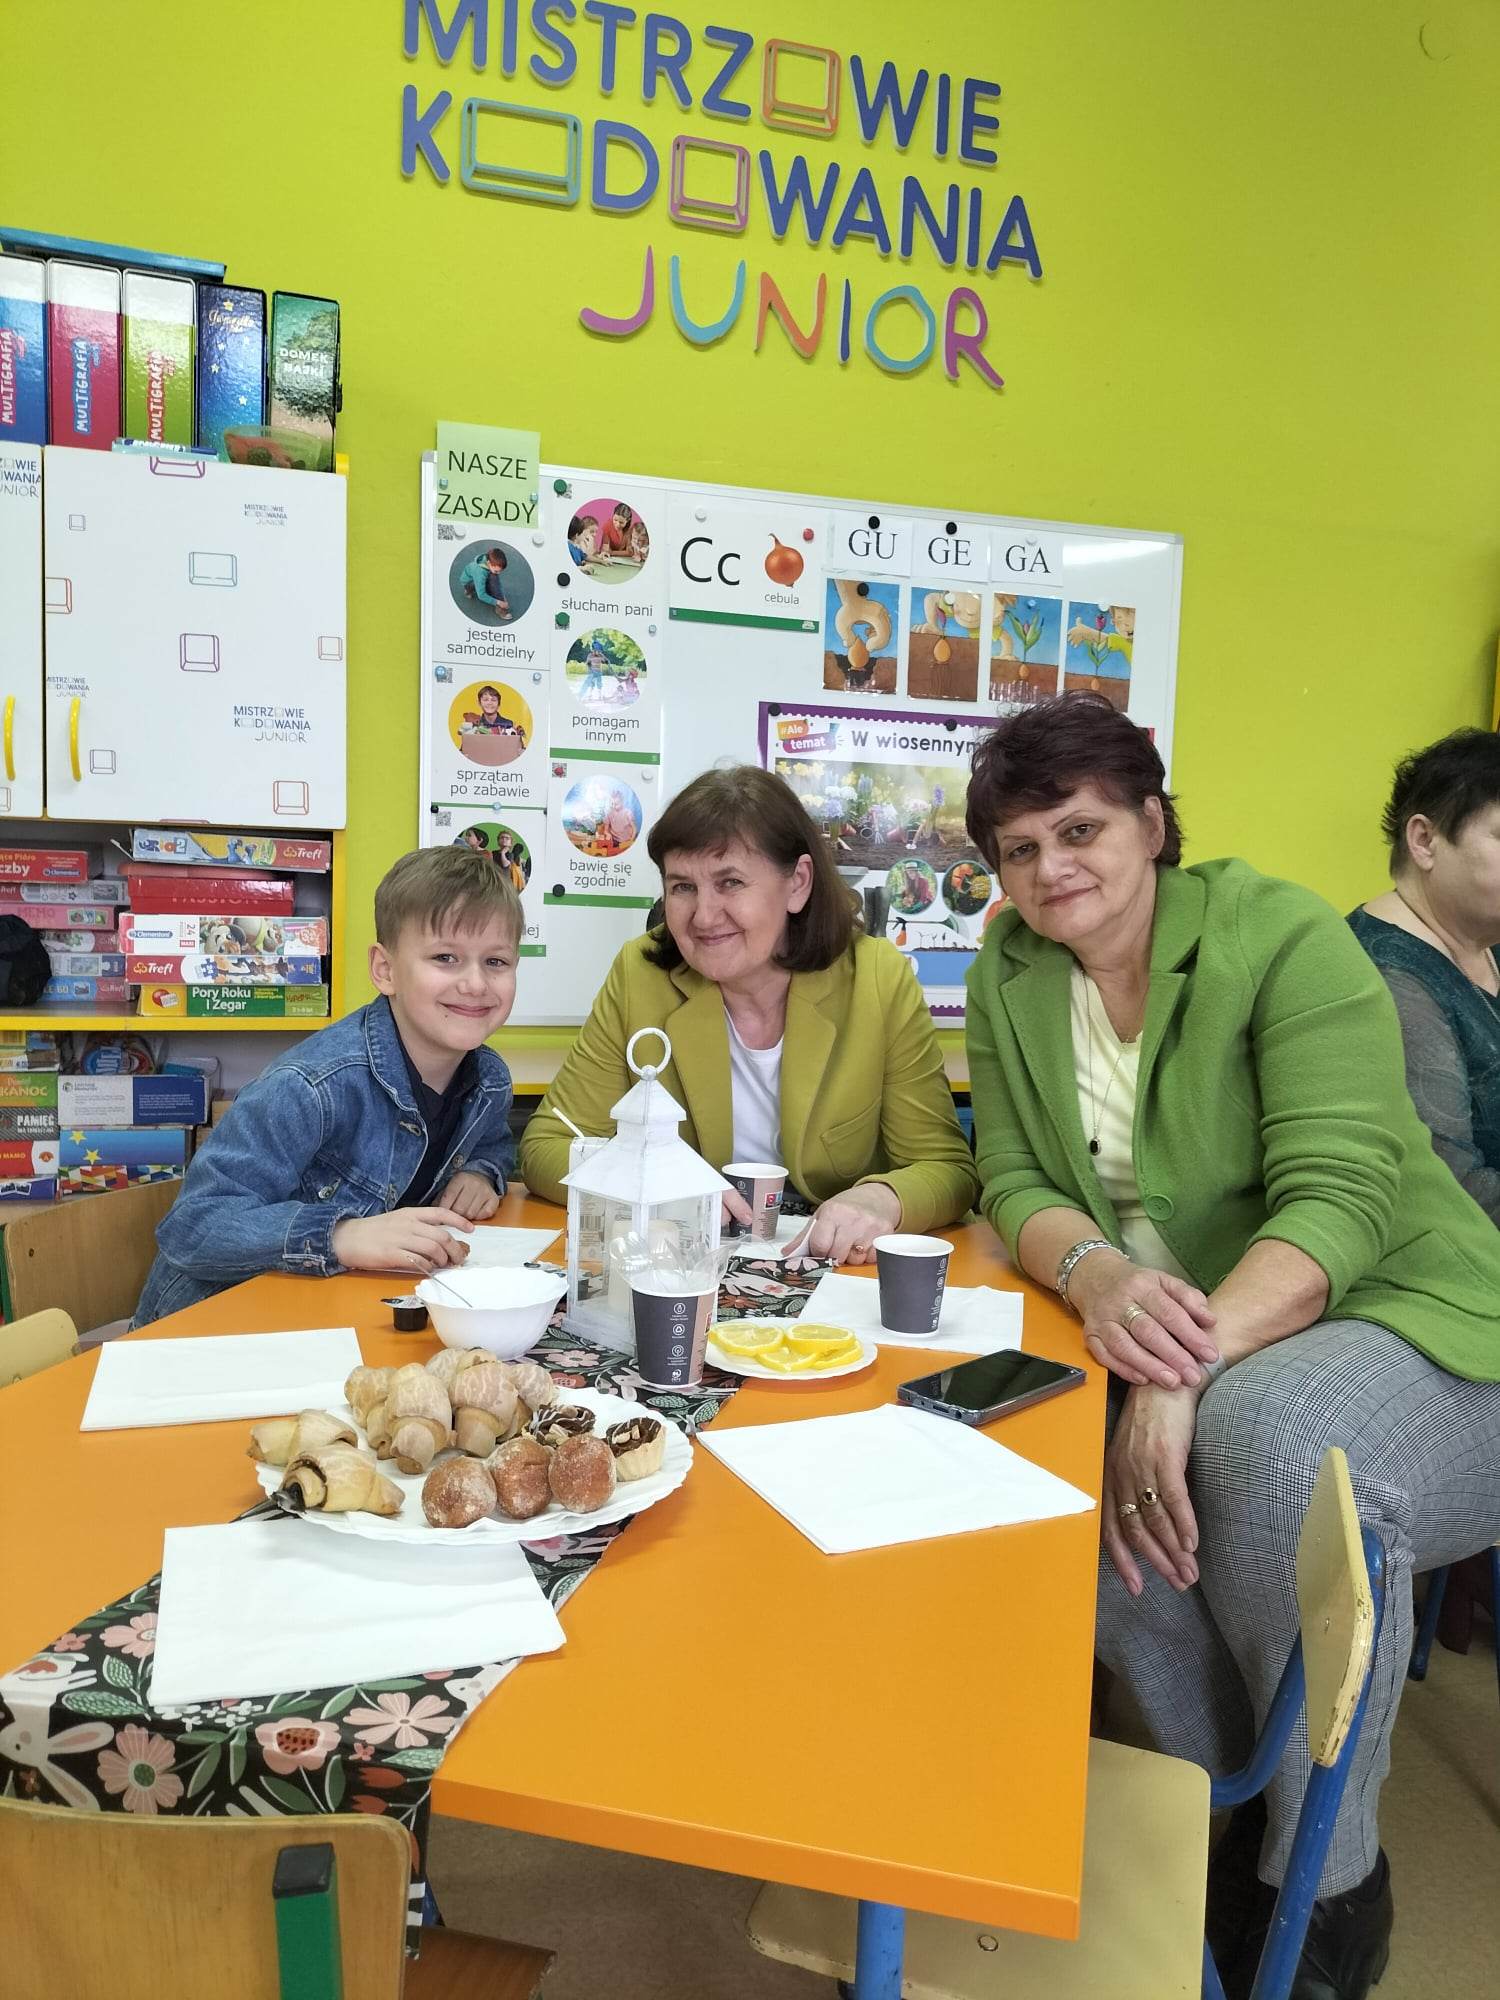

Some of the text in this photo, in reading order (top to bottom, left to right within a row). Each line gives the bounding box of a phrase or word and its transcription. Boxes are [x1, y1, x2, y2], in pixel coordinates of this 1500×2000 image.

[579, 244, 1004, 390] JUNIOR
[448, 450, 527, 480] NASZE
[437, 493, 536, 524] ZASADY
[848, 528, 899, 561] GU
[928, 537, 973, 567] GE
[680, 536, 741, 586] Cc
[1005, 545, 1052, 575] GA
[764, 592, 800, 605] cebula
[561, 597, 653, 617] słucham pani
[466, 628, 516, 643] jestem
[447, 642, 535, 662] samodzielny
[572, 714, 640, 730] pomagam
[254, 731, 307, 743] JUNIOR
[585, 729, 626, 744] innym
[790, 736, 826, 750] temat
[851, 730, 869, 748] W
[457, 769, 523, 784] sprzątam
[450, 783, 530, 798] po zabawie
[297, 847, 322, 859] Trefl
[569, 859, 632, 876] bawię się
[574, 874, 626, 888] zgodnie
[148, 962, 173, 975] Trefl
[192, 987, 220, 1000] Pory
[222, 986, 251, 998] Roku
[213, 1000, 246, 1012] Zegar
[0, 1085, 48, 1097] KANOC
